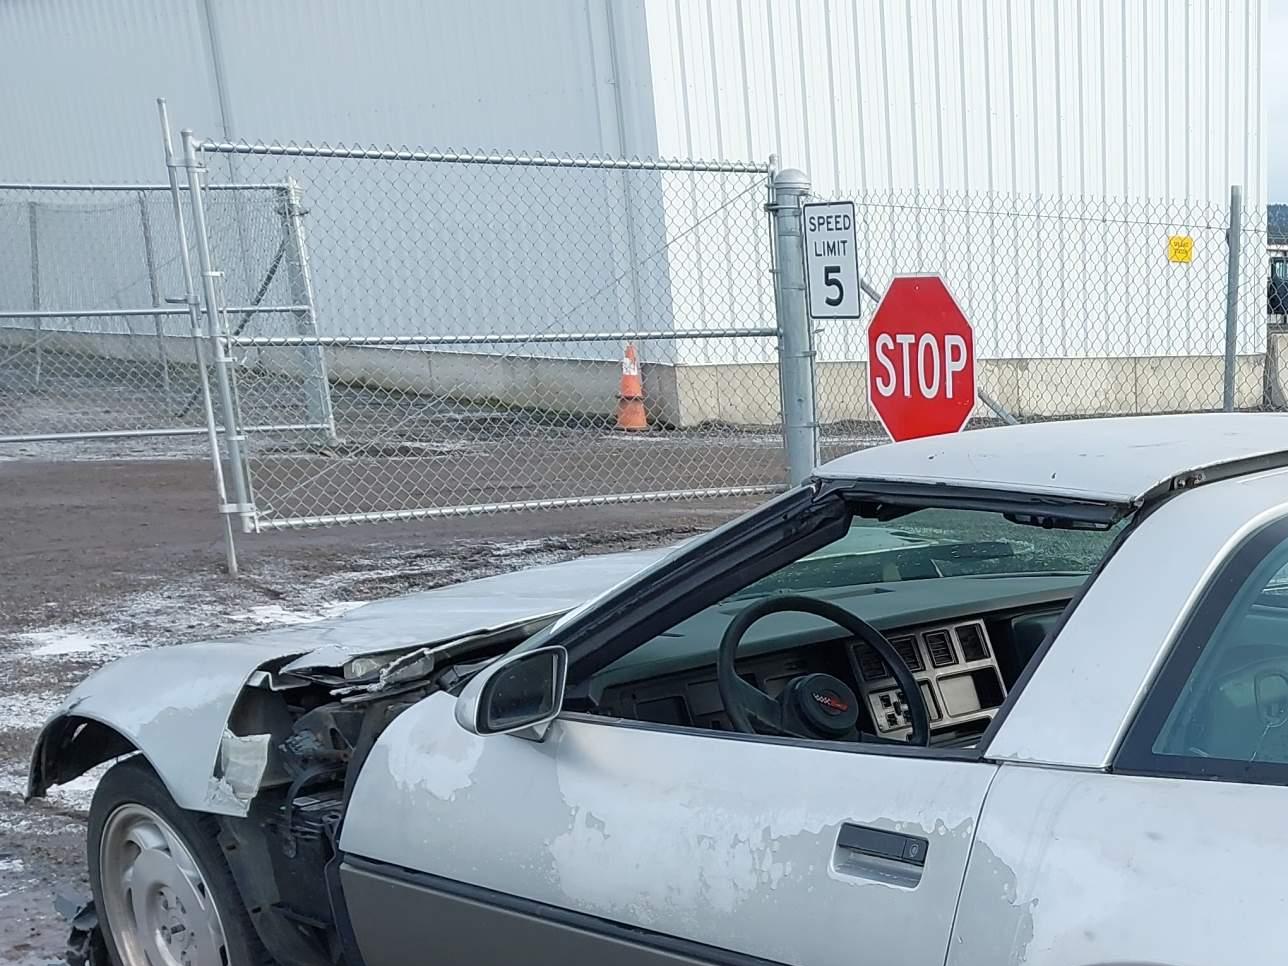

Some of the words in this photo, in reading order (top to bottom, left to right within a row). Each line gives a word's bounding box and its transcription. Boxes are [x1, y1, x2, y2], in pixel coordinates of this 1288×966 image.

[808, 214, 851, 232] SPEED
[814, 240, 848, 257] LIMIT
[824, 266, 844, 307] 5
[875, 333, 968, 399] STOP
